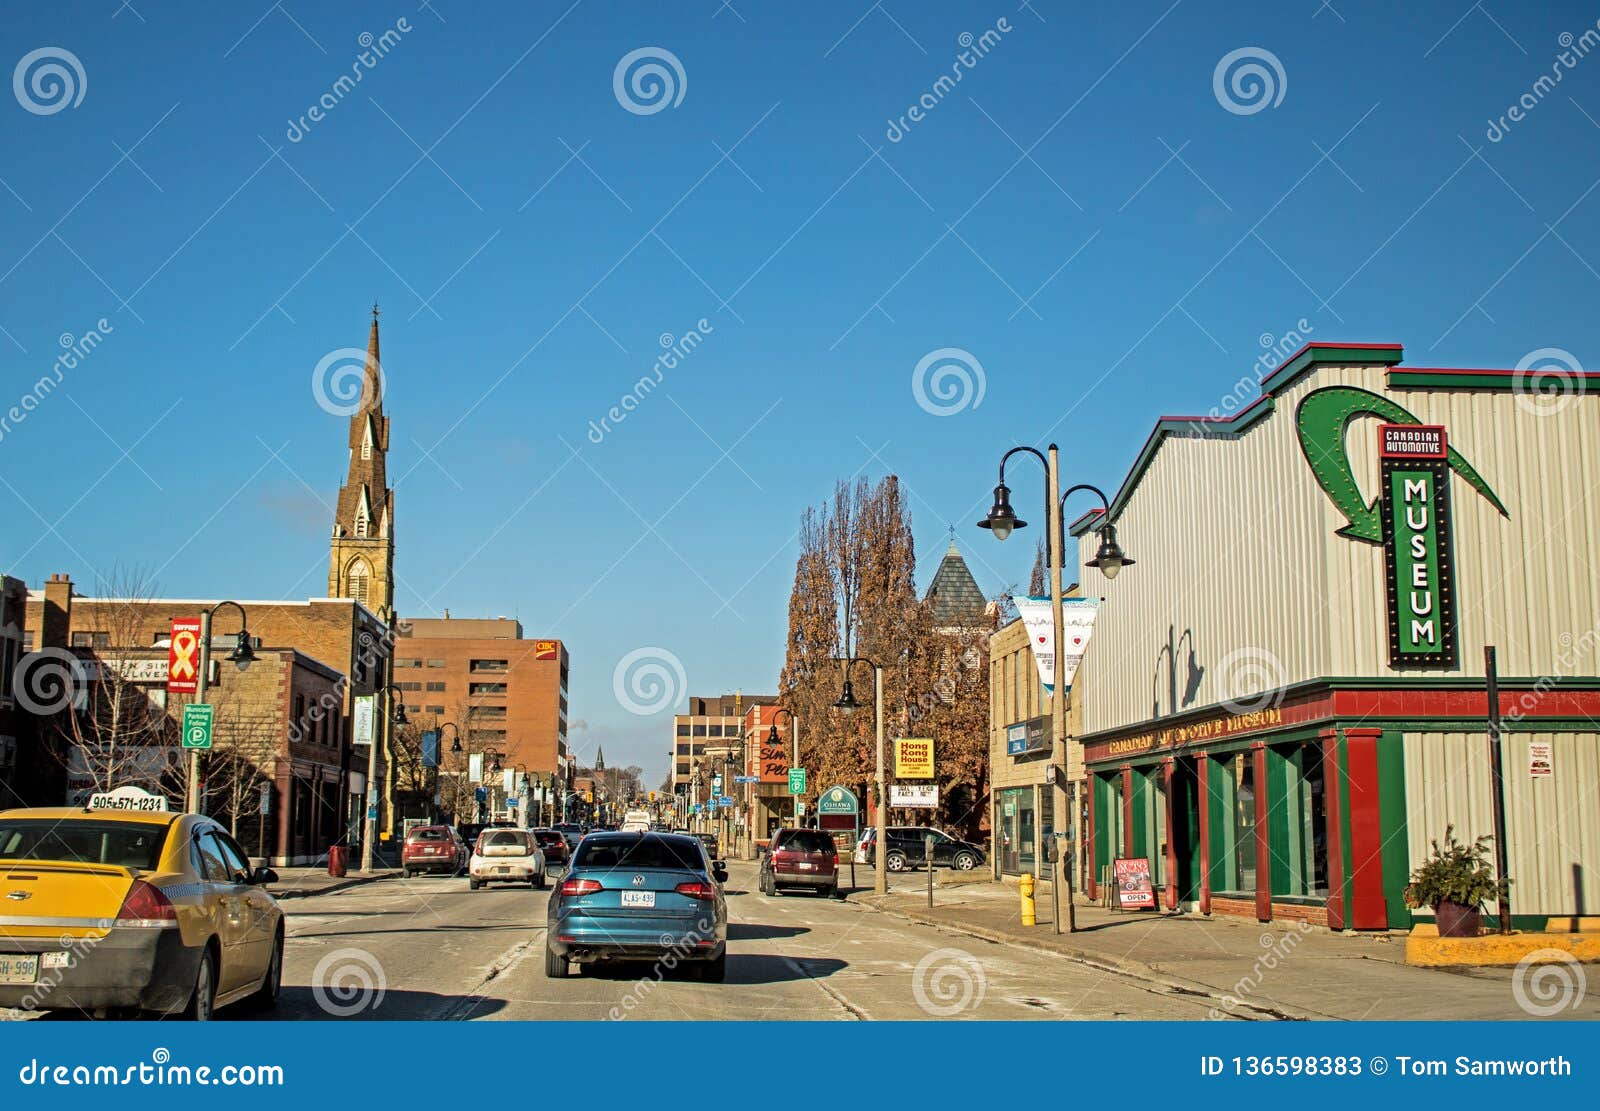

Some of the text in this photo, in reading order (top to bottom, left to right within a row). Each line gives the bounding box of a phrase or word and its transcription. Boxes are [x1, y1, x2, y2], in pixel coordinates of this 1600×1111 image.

[1386, 431, 1439, 442] CANADIAN
[1386, 441, 1440, 453] AUTOMOTIVE
[1403, 479, 1435, 644] MUSEUM
[537, 642, 556, 650] CIBC
[1109, 735, 1154, 754] CANADIAN
[1227, 707, 1282, 732] MUSEUM
[900, 742, 928, 750] Hong
[900, 749, 928, 757] Kong
[93, 796, 161, 811] 905-571-1234
